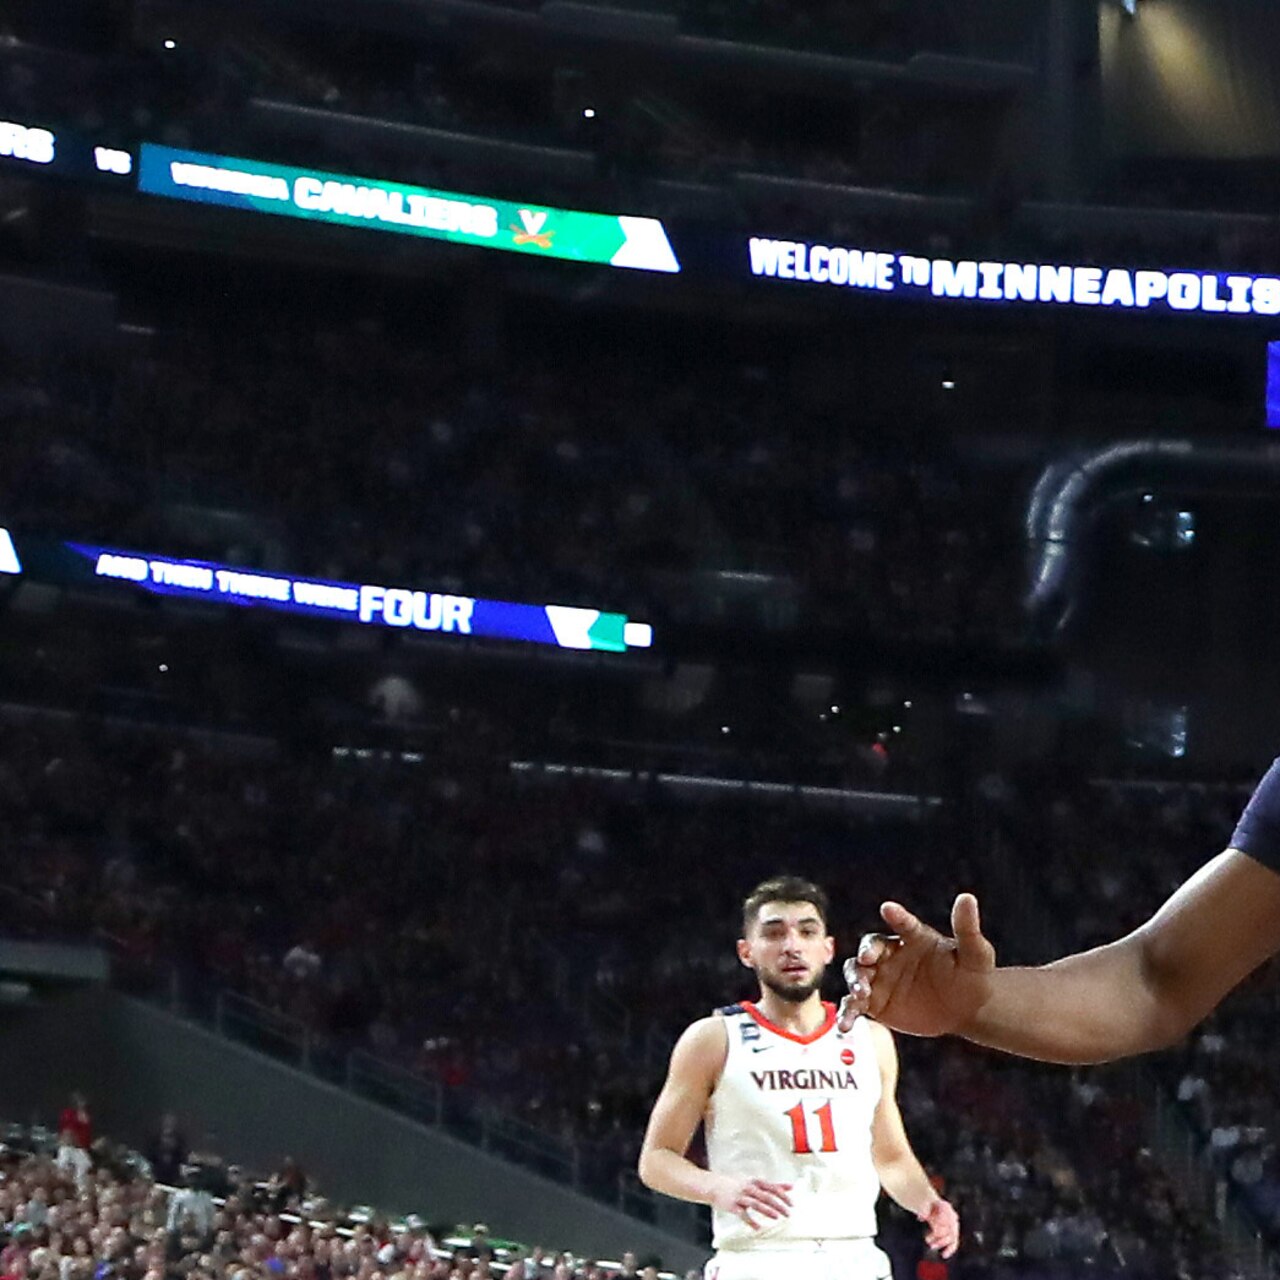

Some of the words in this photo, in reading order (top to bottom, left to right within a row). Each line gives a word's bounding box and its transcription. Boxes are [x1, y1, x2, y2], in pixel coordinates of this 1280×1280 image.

[293, 177, 499, 237] CAVALIERS
[749, 237, 895, 290] WELCOME
[899, 255, 930, 286] TO
[359, 585, 473, 634] FOUR
[749, 1068, 859, 1091] VIRGINIA
[782, 1097, 839, 1154] 11
